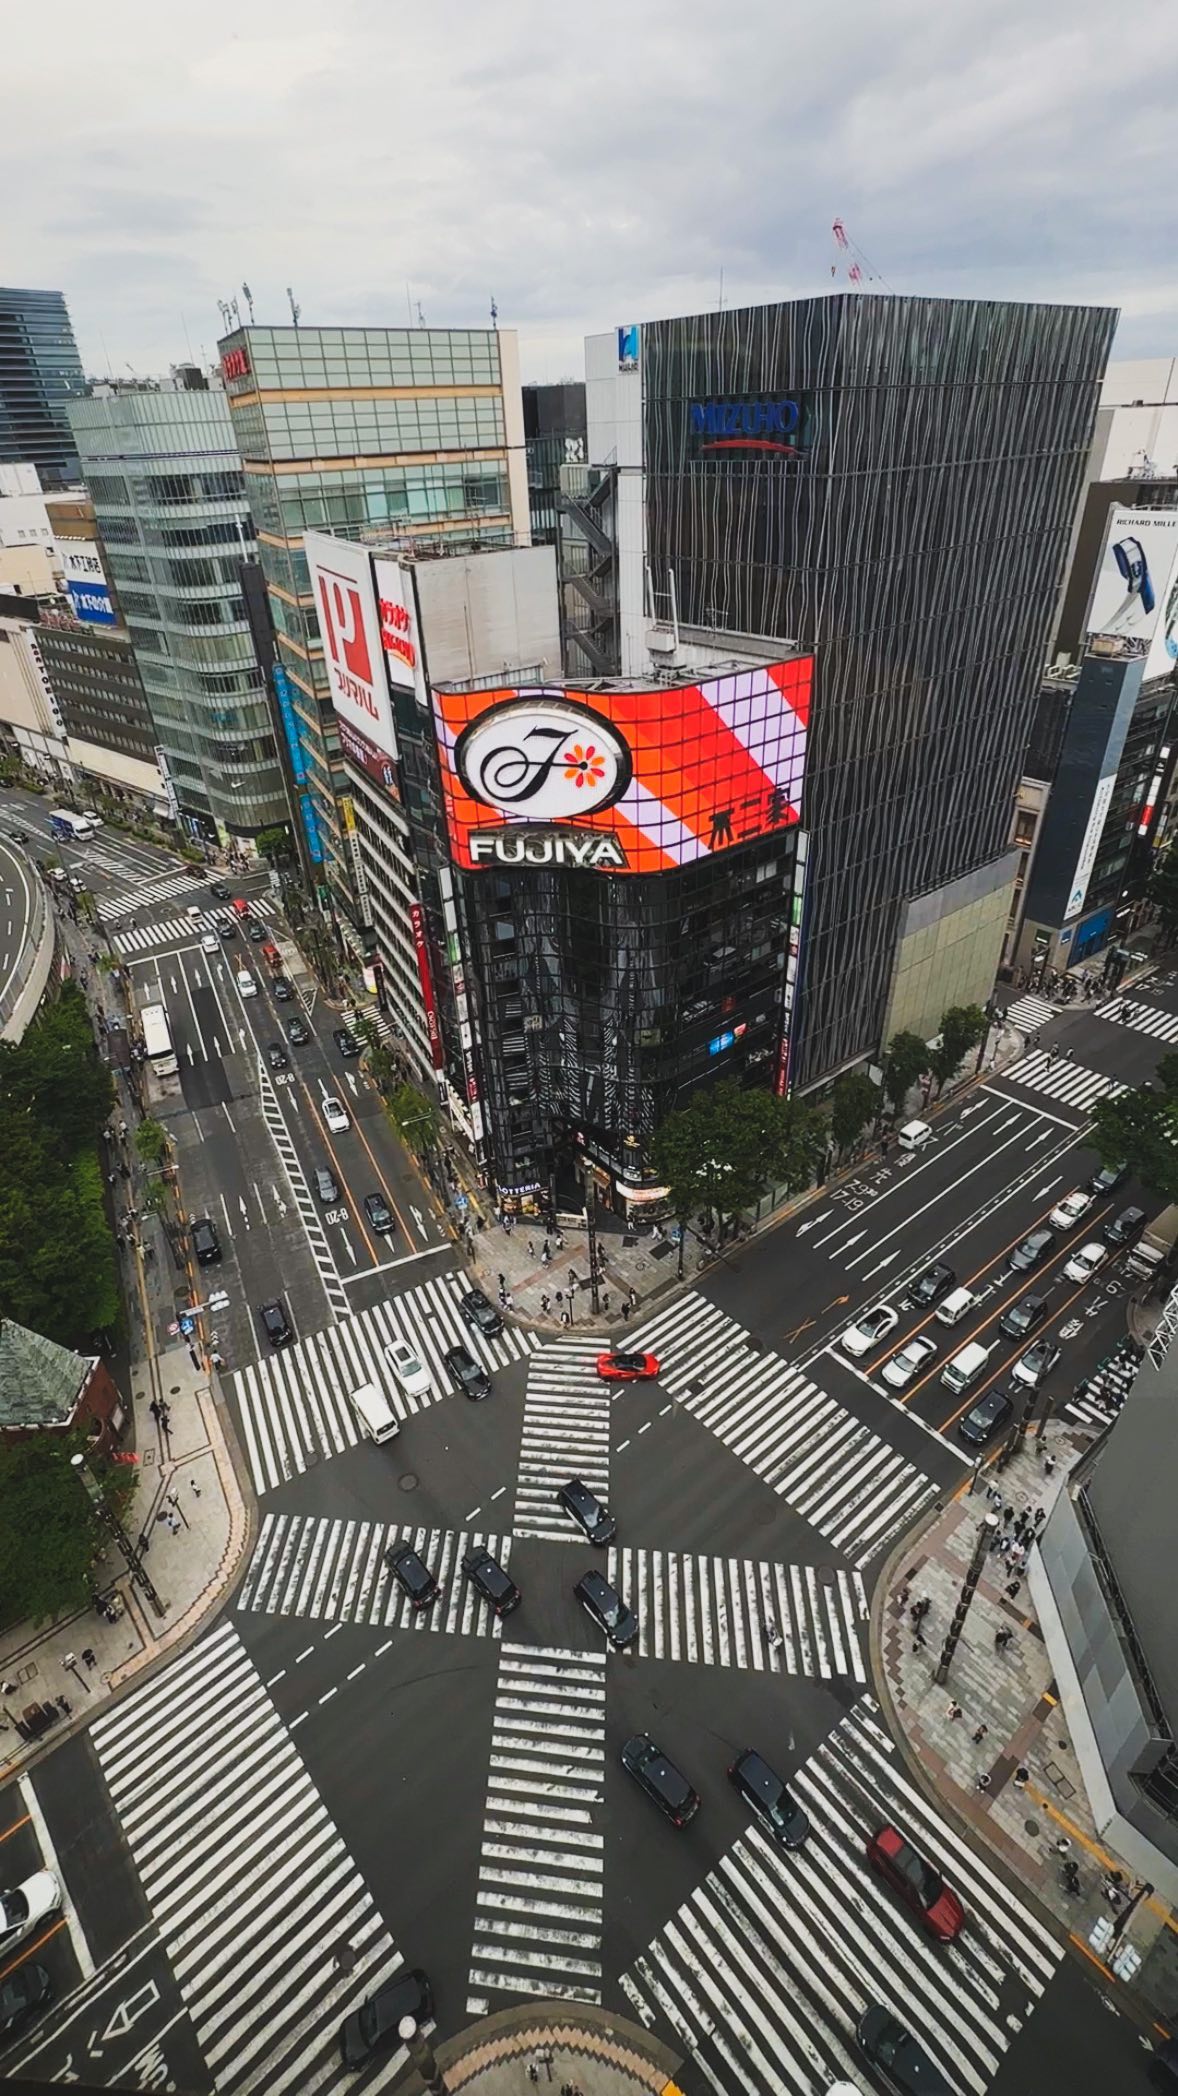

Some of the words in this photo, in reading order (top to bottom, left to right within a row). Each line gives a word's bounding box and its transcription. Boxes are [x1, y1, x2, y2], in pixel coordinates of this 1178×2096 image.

[691, 400, 799, 434] MIZUHO
[1117, 519, 1151, 527] RICHARD
[1153, 520, 1177, 528] MILLE
[334, 667, 380, 720] プリマハム
[708, 787, 791, 850] 不二家
[469, 839, 623, 865] FUJIYA
[275, 1073, 295, 1086] 8-20
[498, 1182, 541, 1195] LOTTERIA
[829, 1188, 864, 1212] 17-19
[325, 1207, 349, 1225] 8-20
